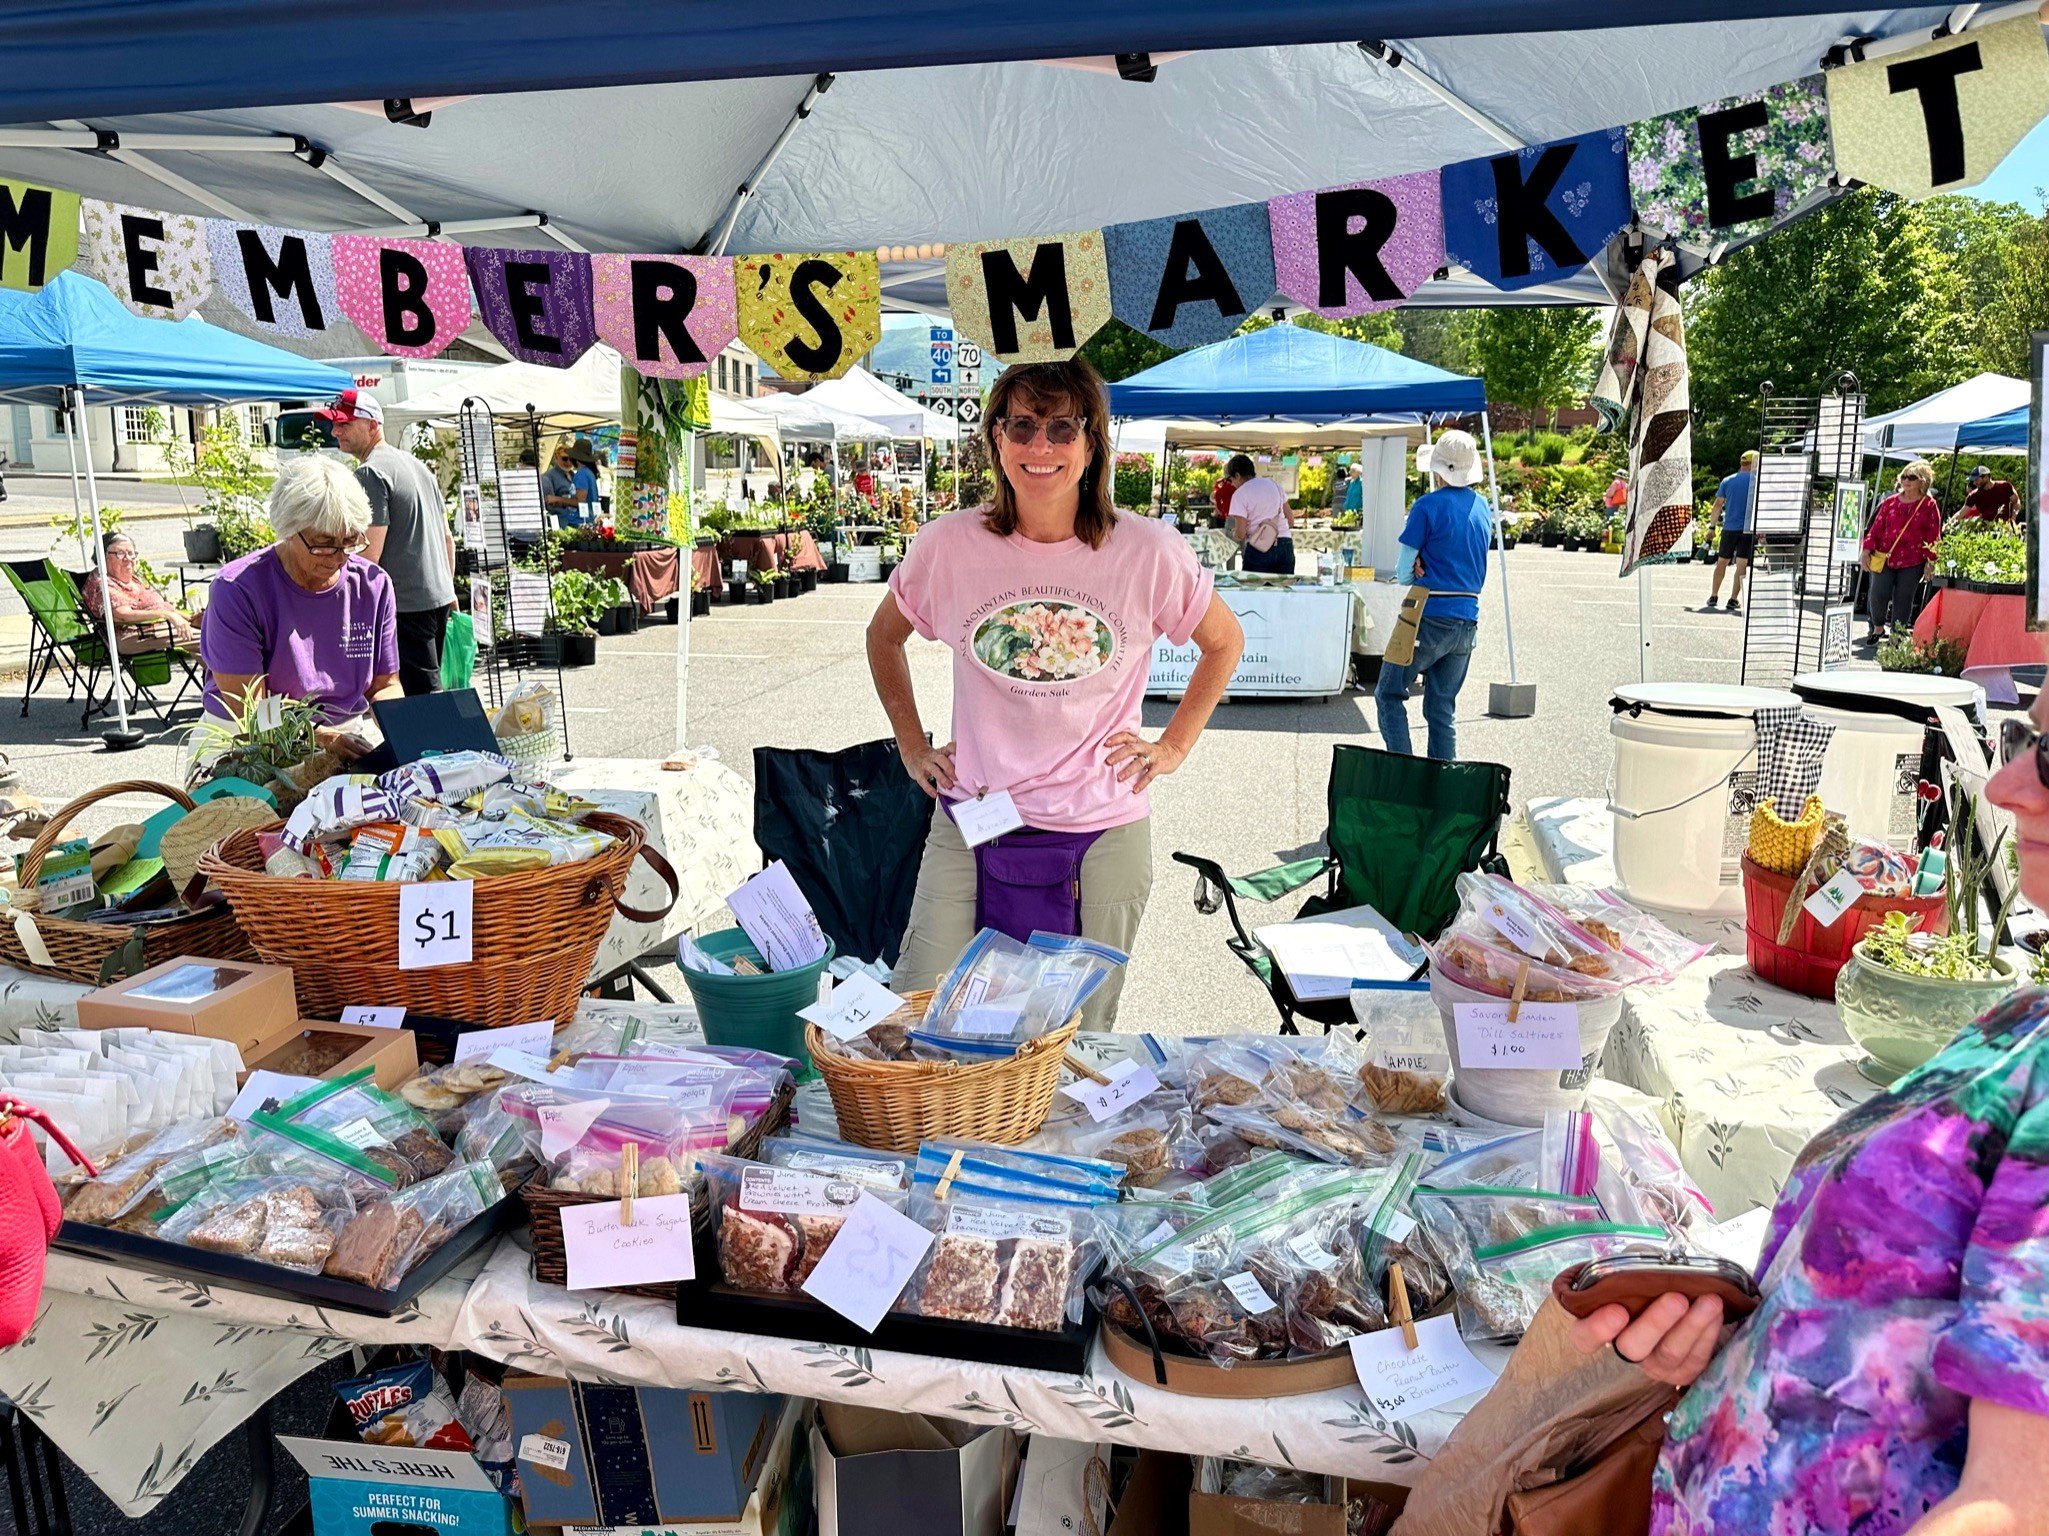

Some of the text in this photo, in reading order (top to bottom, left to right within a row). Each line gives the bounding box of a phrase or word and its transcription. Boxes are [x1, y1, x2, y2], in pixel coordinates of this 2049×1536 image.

[981, 41, 1983, 353] MARKET
[936, 331, 948, 339] TO
[932, 349, 952, 362] 40
[961, 349, 978, 363] 70
[931, 386, 952, 394] SOUTH
[959, 386, 980, 395] NORTH
[937, 402, 945, 415] 9
[964, 404, 973, 417] 9
[961, 588, 1017, 630] MOUNTAIN
[1021, 585, 1108, 612] BEAUTIFICATION
[1010, 685, 1071, 698] Garden Sale
[414, 907, 461, 949] $1
[777, 1171, 796, 1179] June
[826, 1184, 855, 1195] Great
[347, 1386, 412, 1425] RUFFLES
[321, 1454, 455, 1479] HERE'S THE
[368, 1493, 441, 1511] PERFECT FOR
[352, 1506, 460, 1527] SUMMER SNACKING!
